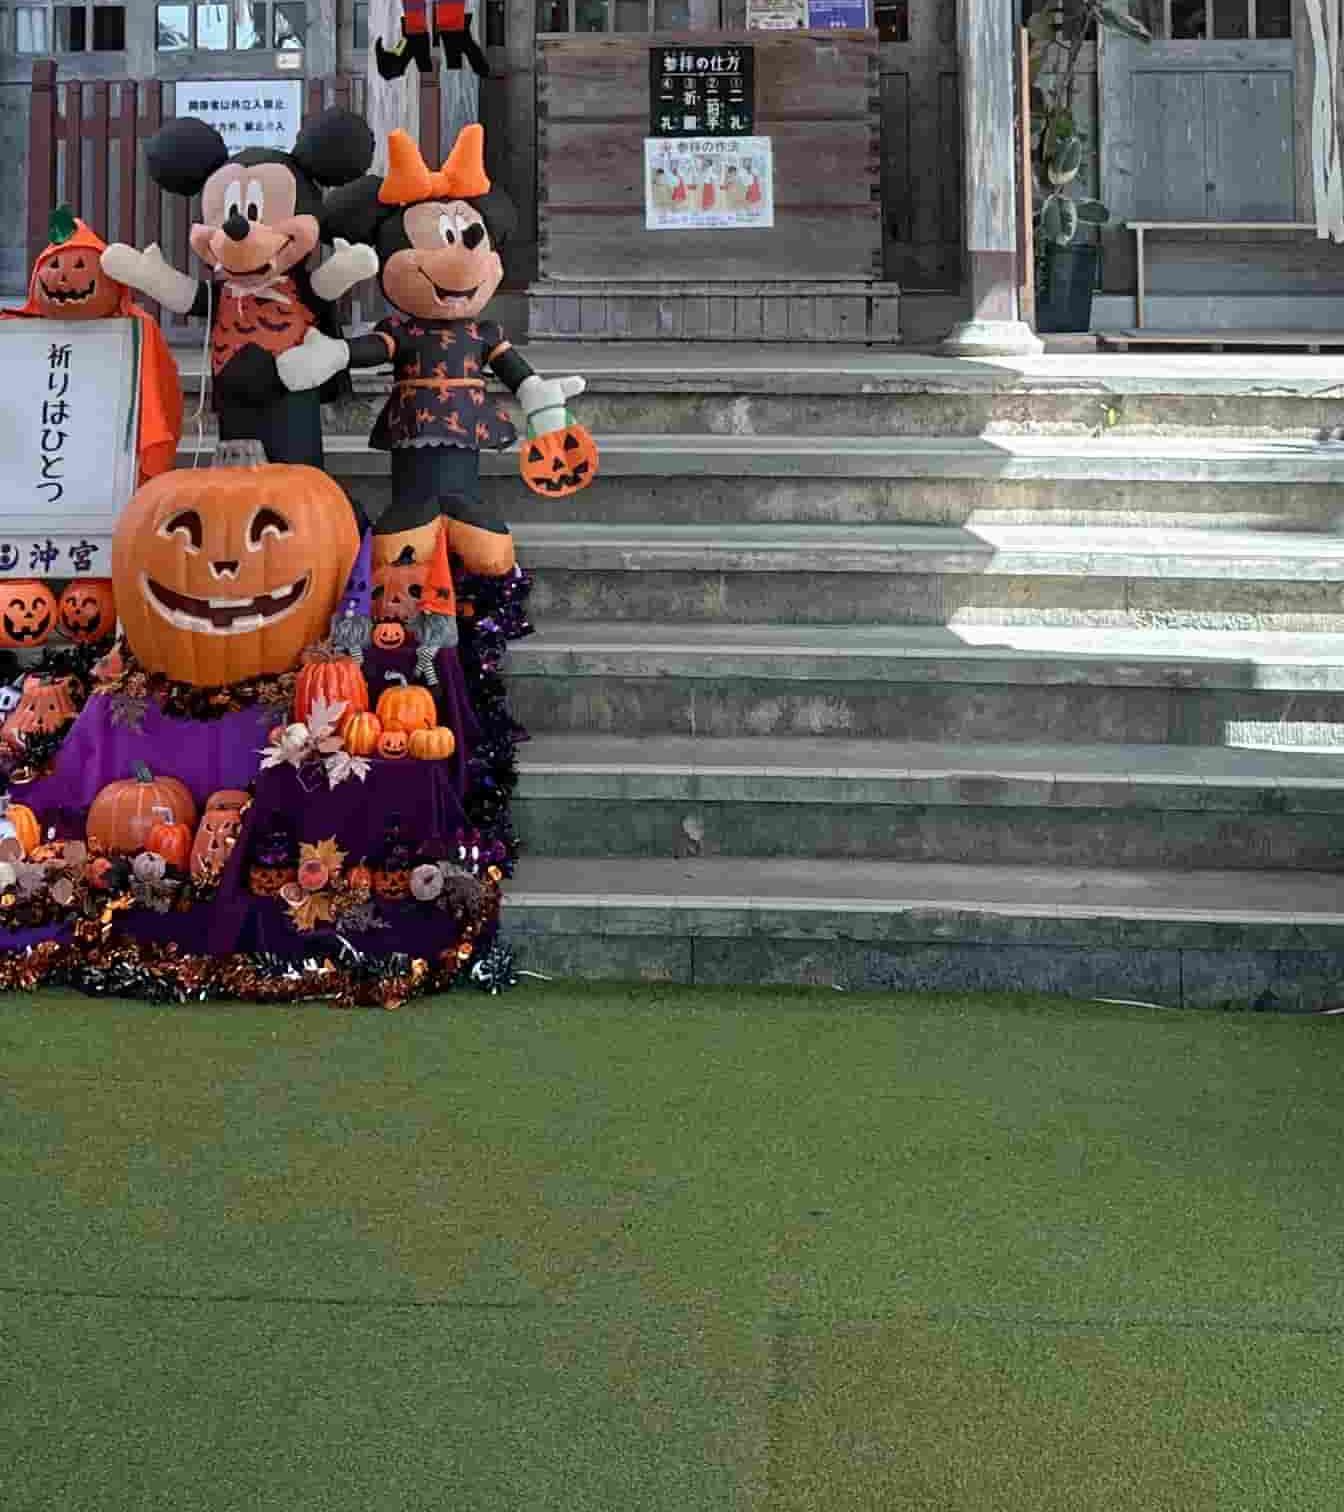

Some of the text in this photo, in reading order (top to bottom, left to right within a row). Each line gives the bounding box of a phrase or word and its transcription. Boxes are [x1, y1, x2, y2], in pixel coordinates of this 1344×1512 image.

[36, 343, 72, 502] 祈りはひとつ
[29, 539, 99, 573] 沖宮
